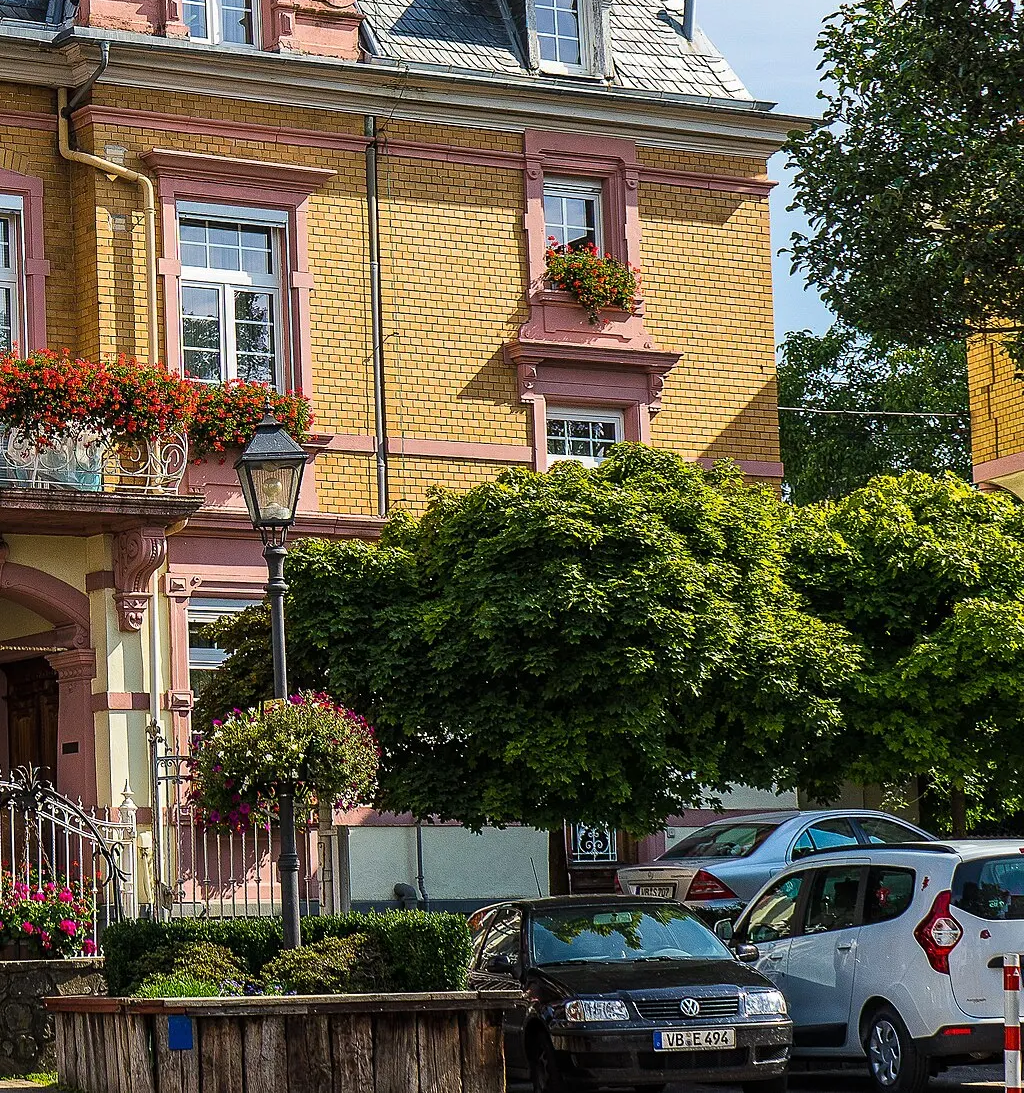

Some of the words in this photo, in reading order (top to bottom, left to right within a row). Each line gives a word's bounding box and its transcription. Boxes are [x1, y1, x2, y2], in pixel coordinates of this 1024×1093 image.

[666, 1033, 685, 1047] VB
[692, 1032, 702, 1046] E
[704, 1031, 729, 1046] 494
